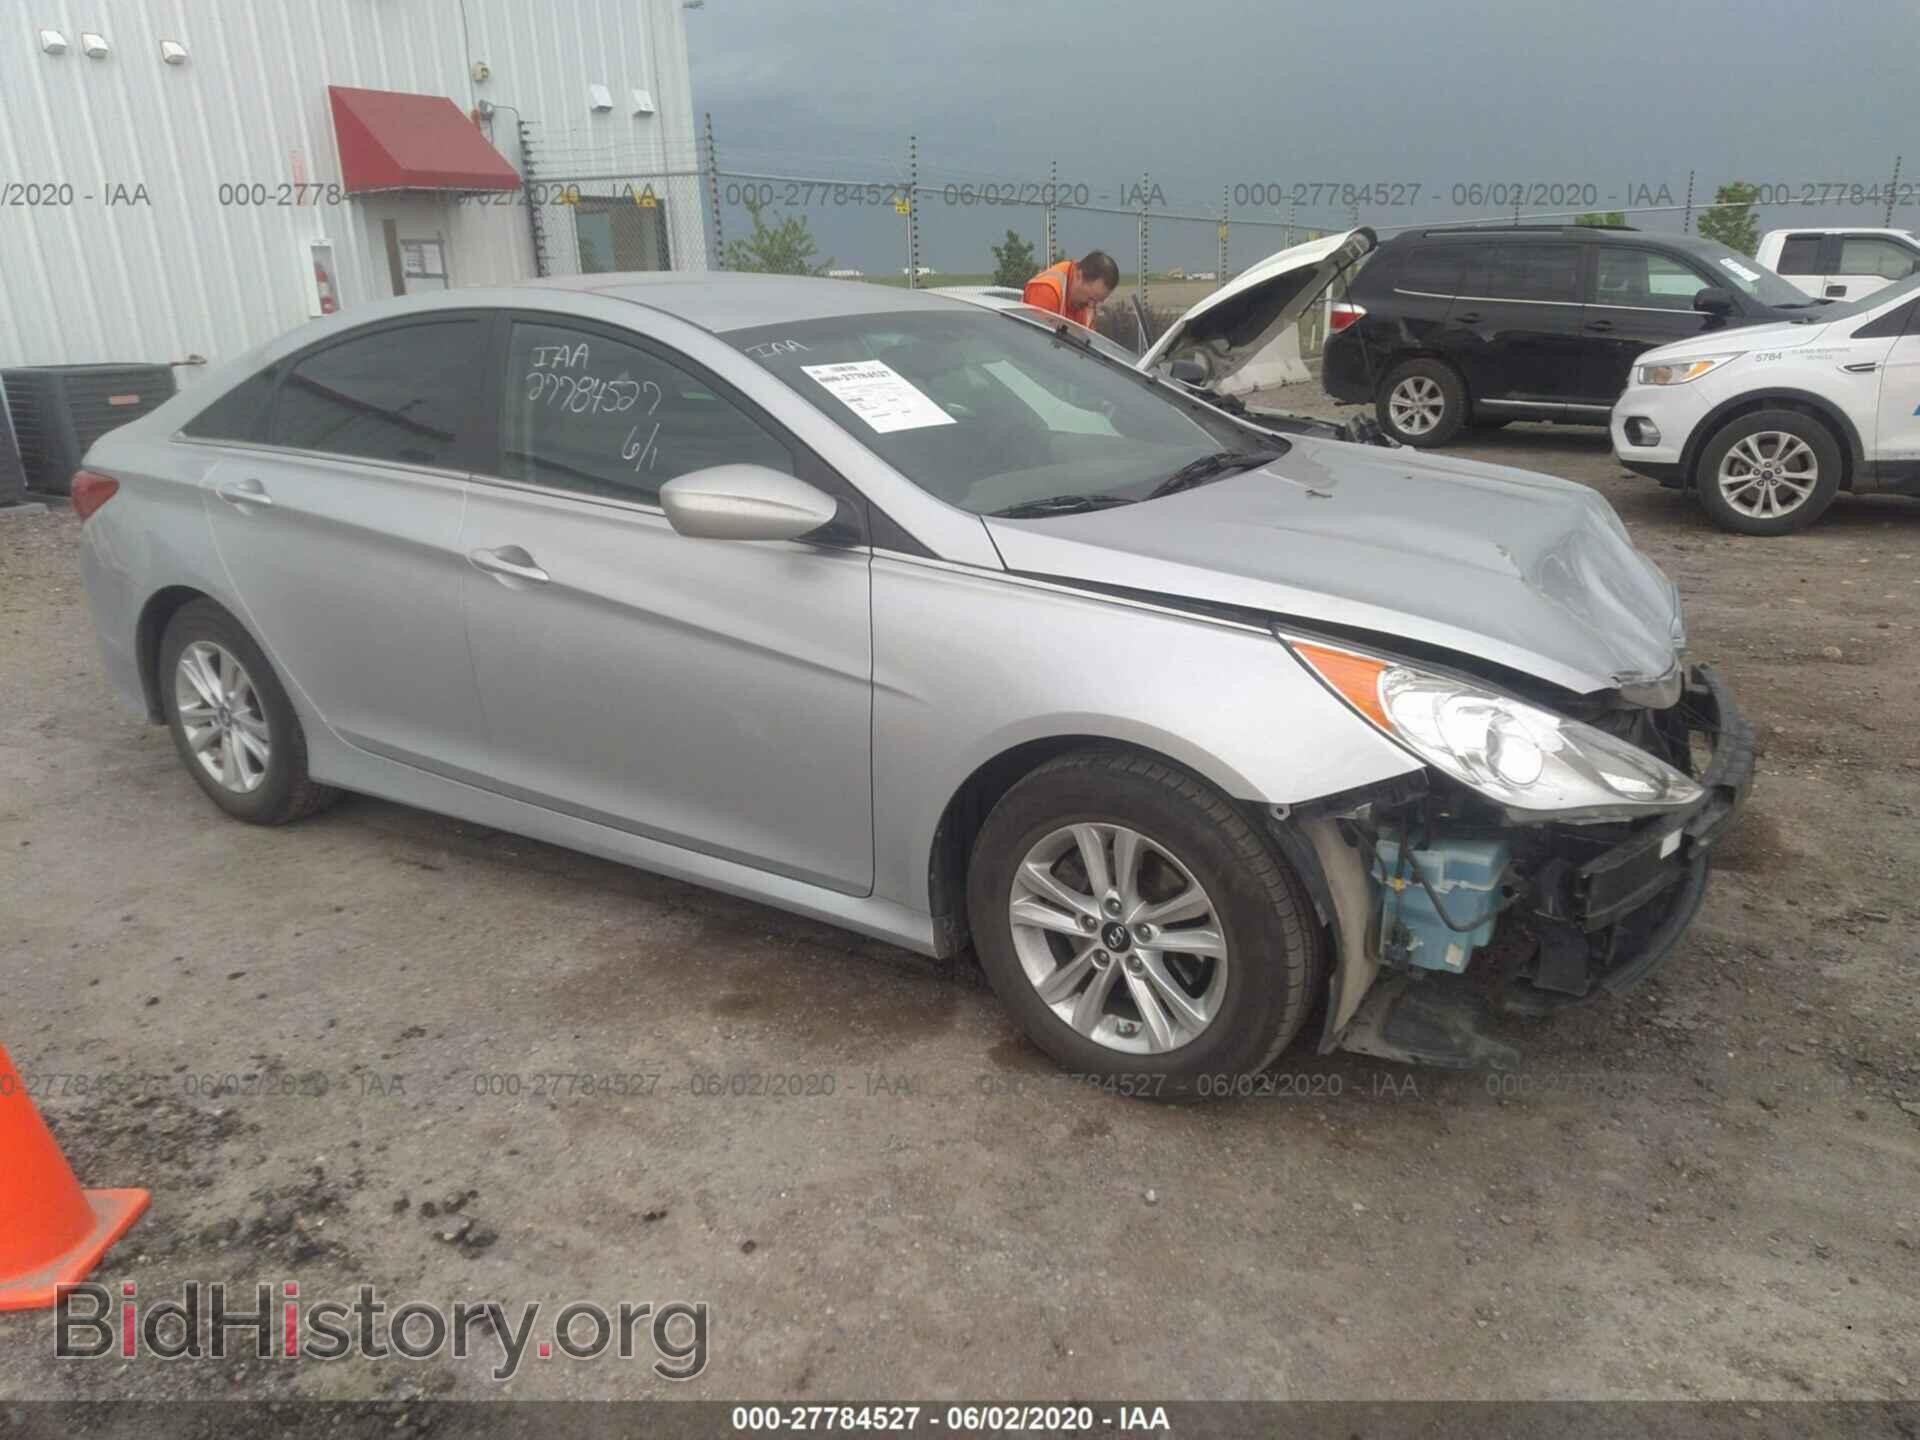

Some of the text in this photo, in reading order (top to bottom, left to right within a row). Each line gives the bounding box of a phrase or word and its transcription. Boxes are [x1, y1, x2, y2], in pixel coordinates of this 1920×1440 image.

[533, 343, 589, 369] IAA
[744, 339, 810, 358] IAA
[525, 371, 662, 416] 27784527
